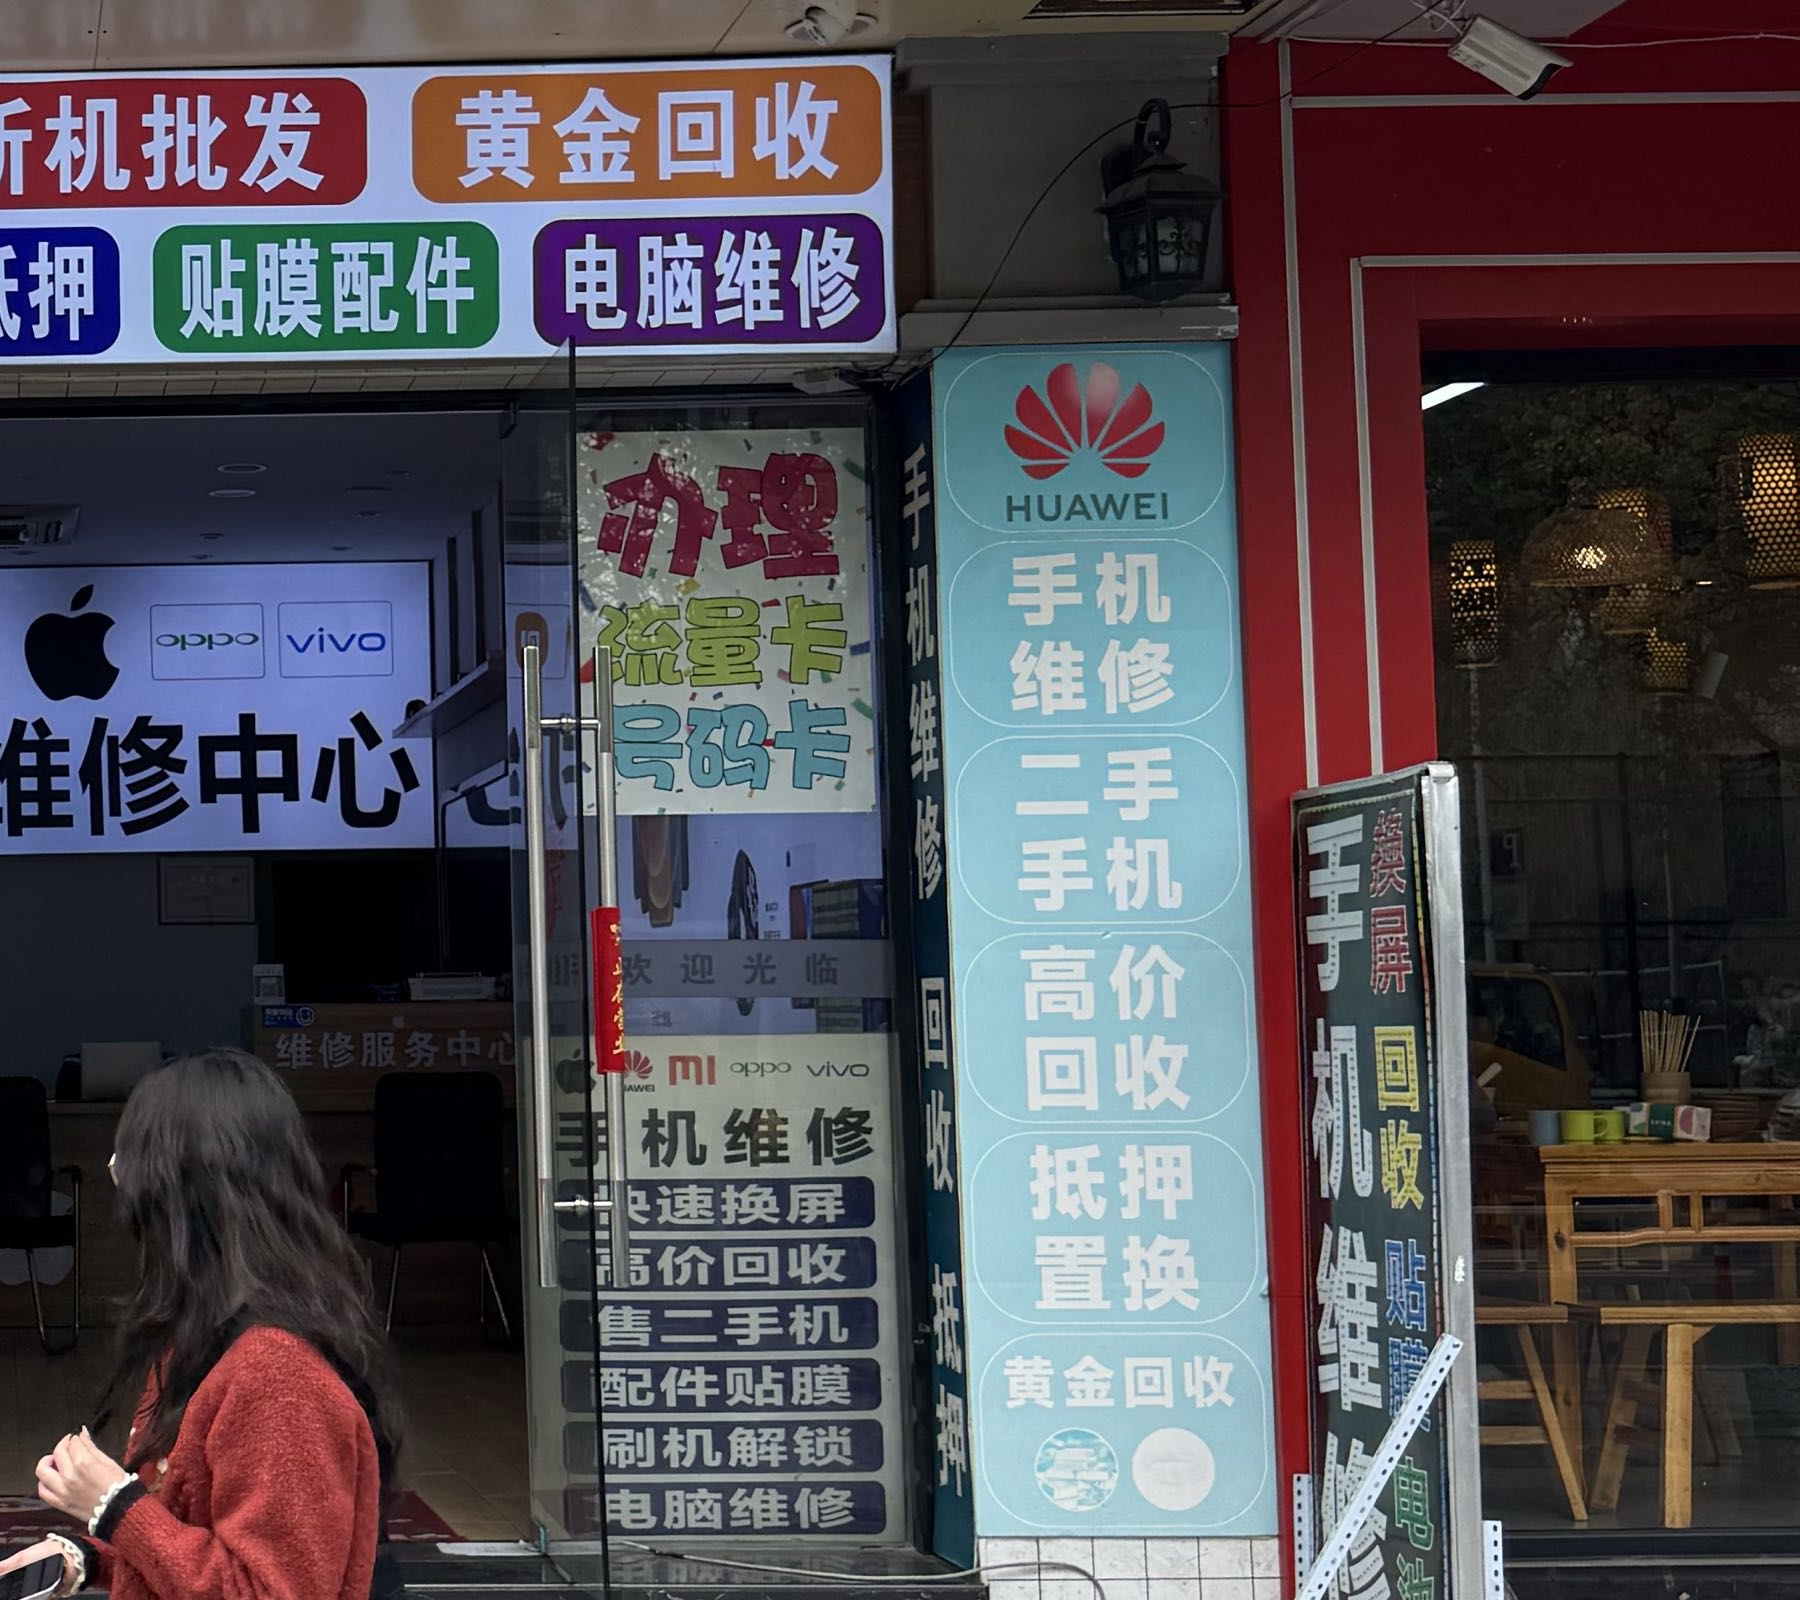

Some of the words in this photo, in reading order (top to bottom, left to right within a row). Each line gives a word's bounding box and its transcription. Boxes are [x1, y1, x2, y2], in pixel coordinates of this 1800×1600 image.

[459, 82, 840, 187] 黄金回收
[180, 236, 475, 339] 贴膜配件
[566, 228, 863, 330] 电脑维修
[597, 452, 840, 580] 办理
[1007, 492, 1168, 522] HUAWEI
[1008, 553, 1170, 626] 手机
[597, 595, 848, 686] 流量卡
[903, 443, 945, 902] 手机维修
[1010, 639, 1175, 716] 维修
[614, 699, 851, 791] 号码卡
[1016, 747, 1178, 821] 二手
[1018, 837, 1182, 911] 手机
[621, 952, 840, 987] 欢迎光临
[1020, 945, 1184, 1021] 高价
[276, 1030, 515, 1070] 维修服务中心
[921, 976, 958, 1193] 回收
[1026, 1036, 1190, 1111] 回收
[555, 1106, 874, 1168] 手机维修
[1373, 1024, 1424, 1209] 回收
[1030, 1145, 1193, 1221] 抵押
[1035, 1235, 1200, 1311] 置换
[598, 1305, 848, 1345] 售二手机
[598, 1366, 851, 1407] 配件贴膜
[933, 1263, 968, 1498] 抵押
[1003, 1356, 1234, 1409] 黄金回收
[602, 1427, 853, 1468] 刷机解锁
[607, 1488, 855, 1530] 电脑维修
